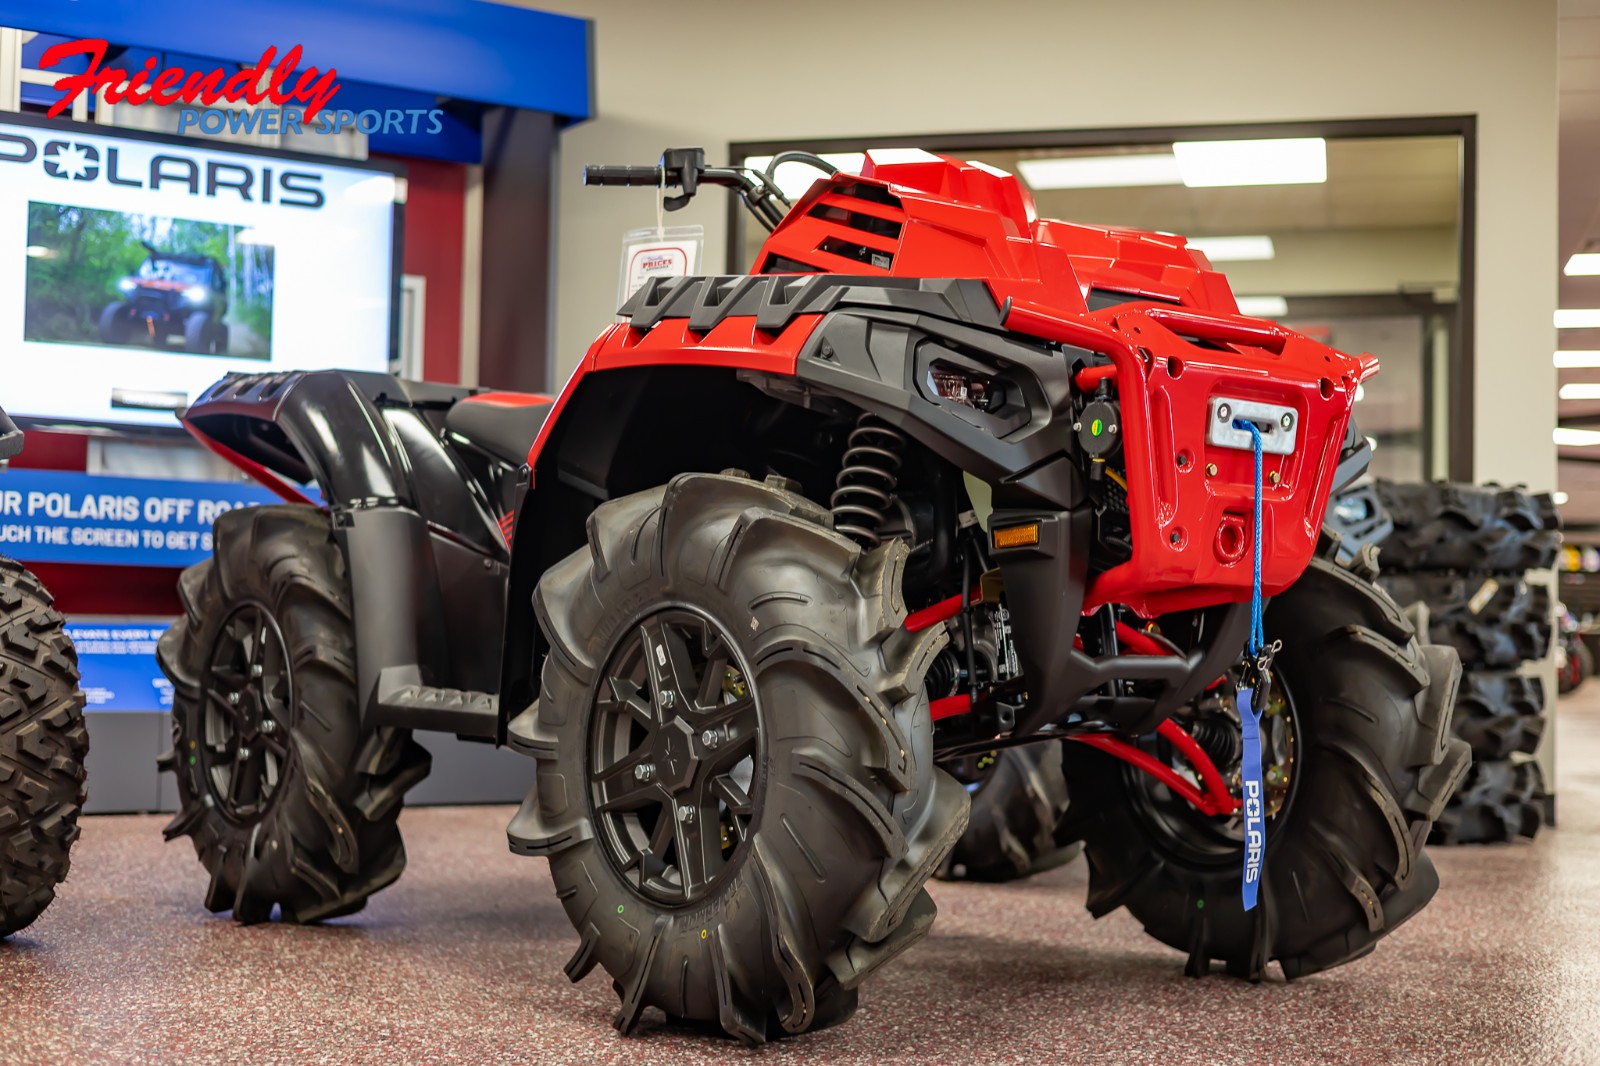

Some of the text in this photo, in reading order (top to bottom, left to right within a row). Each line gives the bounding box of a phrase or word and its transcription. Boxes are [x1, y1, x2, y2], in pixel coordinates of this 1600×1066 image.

[0, 132, 326, 209] POLARIS
[27, 491, 140, 522] POLARIS
[143, 497, 194, 525] OFF
[34, 525, 69, 545] THE
[71, 528, 139, 549] SCREEN
[142, 531, 164, 549] TO
[166, 532, 200, 551] GET
[1246, 781, 1260, 883] POLARIS
